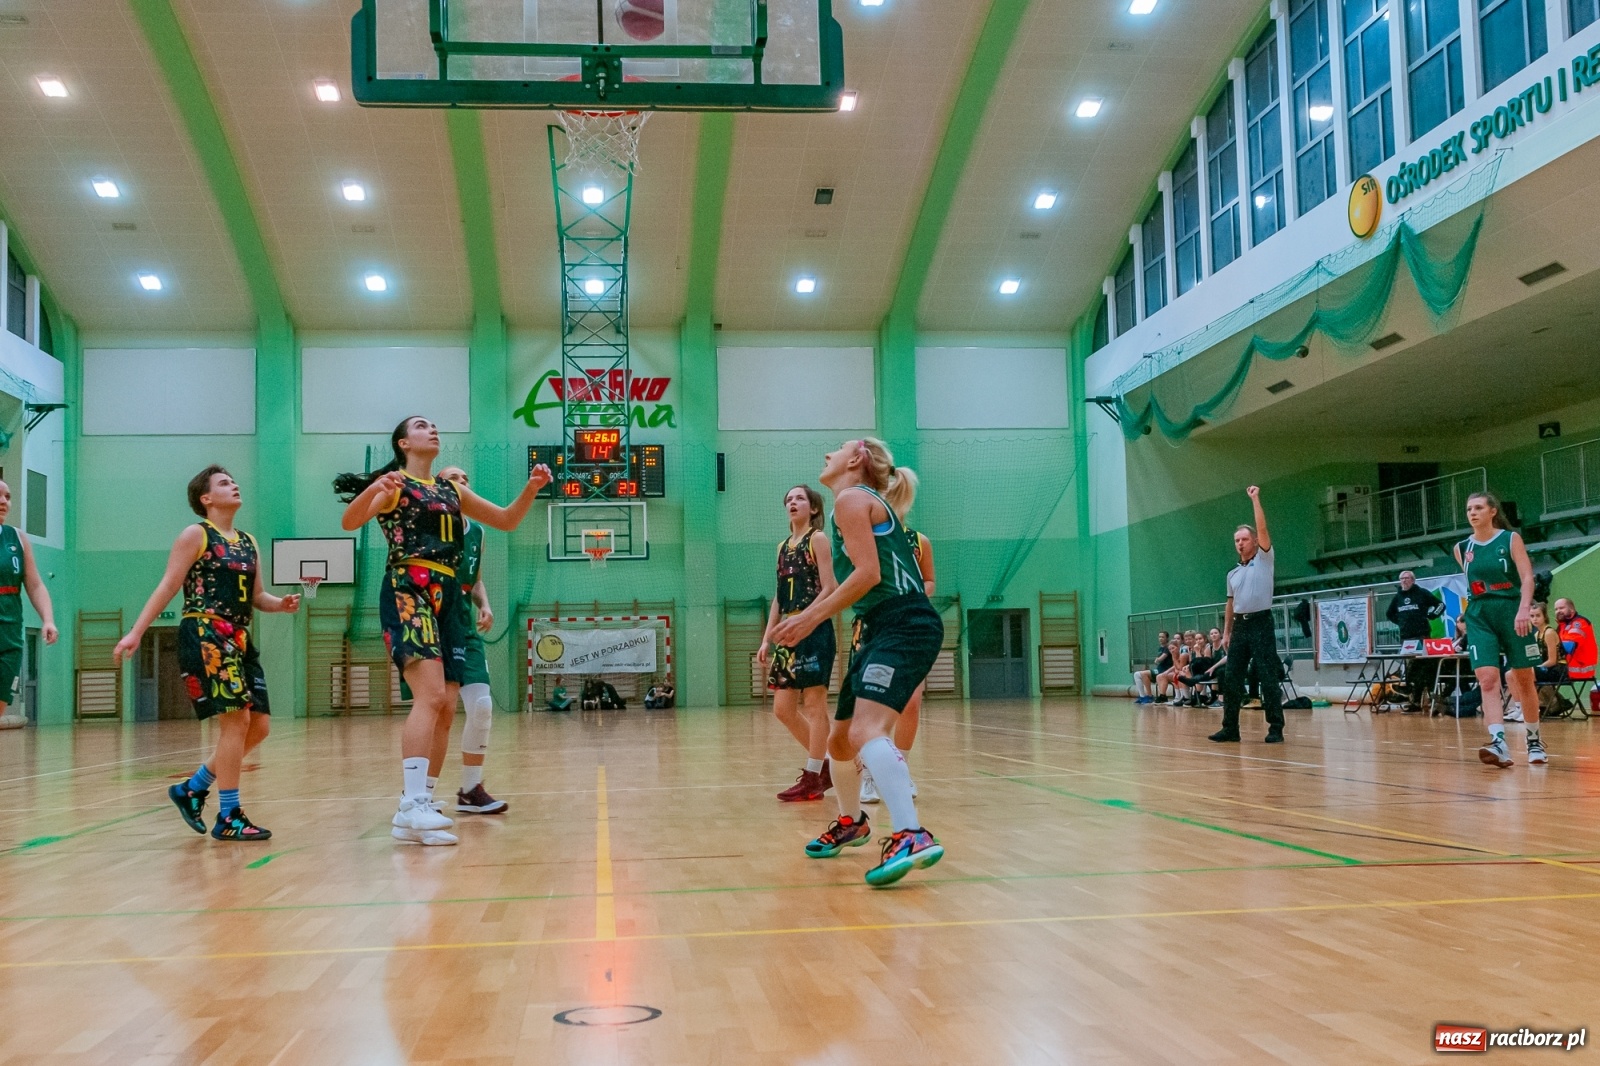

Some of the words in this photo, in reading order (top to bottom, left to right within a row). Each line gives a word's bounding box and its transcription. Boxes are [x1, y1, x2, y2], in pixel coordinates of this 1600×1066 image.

[1386, 130, 1467, 204] OŚRODEK
[1470, 76, 1553, 154] SPORTU
[1557, 67, 1568, 102] I
[1571, 43, 1600, 93] RE
[594, 476, 600, 484] 3
[440, 514, 454, 542] 11
[12, 556, 20, 574] 9
[238, 575, 247, 602] 5
[570, 654, 590, 667] JEST
[591, 650, 600, 659] W
[227, 665, 243, 693] 5
